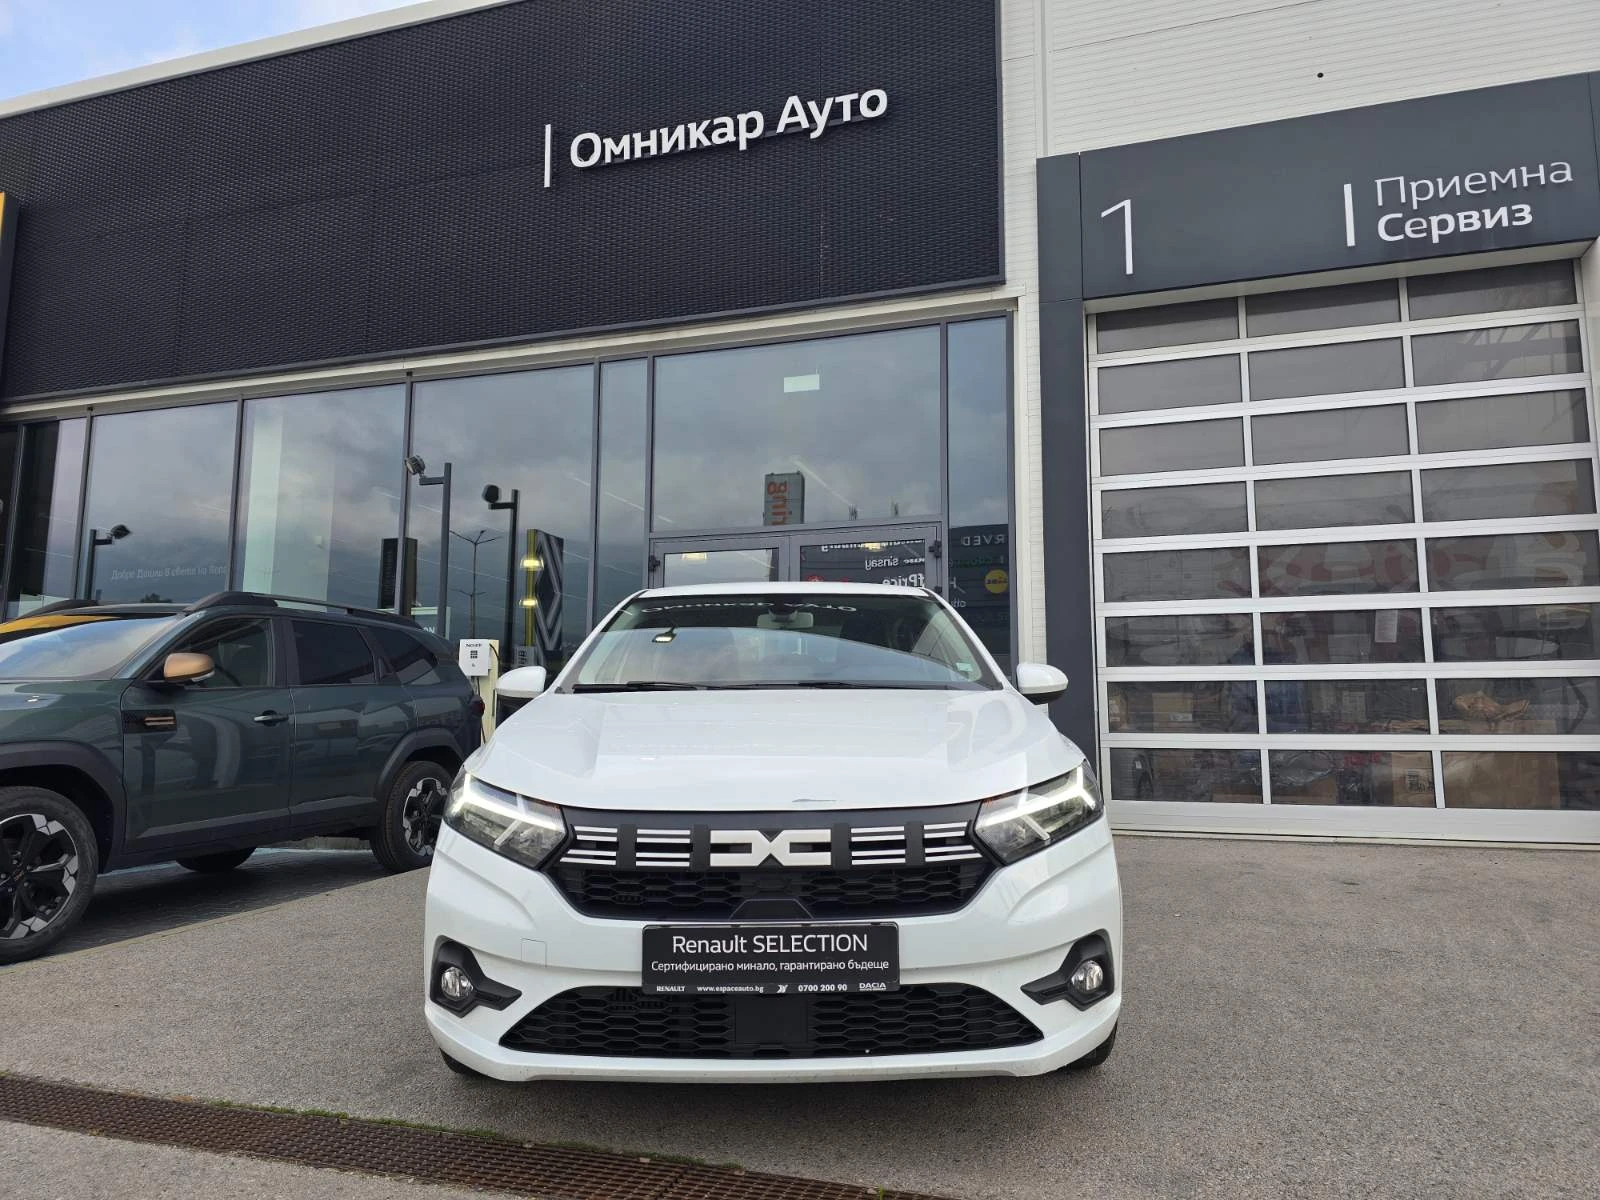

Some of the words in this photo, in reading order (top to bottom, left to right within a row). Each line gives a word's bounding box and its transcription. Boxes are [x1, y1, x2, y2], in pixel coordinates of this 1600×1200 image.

[570, 110, 765, 168] Омникар
[776, 88, 888, 139] Ауто
[1375, 161, 1573, 209] Приемна
[1100, 199, 1134, 275] 1
[1377, 203, 1533, 244] Сервиз
[672, 934, 748, 953] Renault
[753, 934, 868, 953] SELECTION
[651, 960, 735, 973] Сертифицирано
[736, 962, 777, 972] минало,
[780, 961, 846, 973] гарантирано
[848, 959, 889, 971] бъдеще
[798, 984, 819, 992] 0700
[820, 984, 836, 992] 200
[837, 983, 848, 992] 90
[859, 982, 887, 990] DACIA
